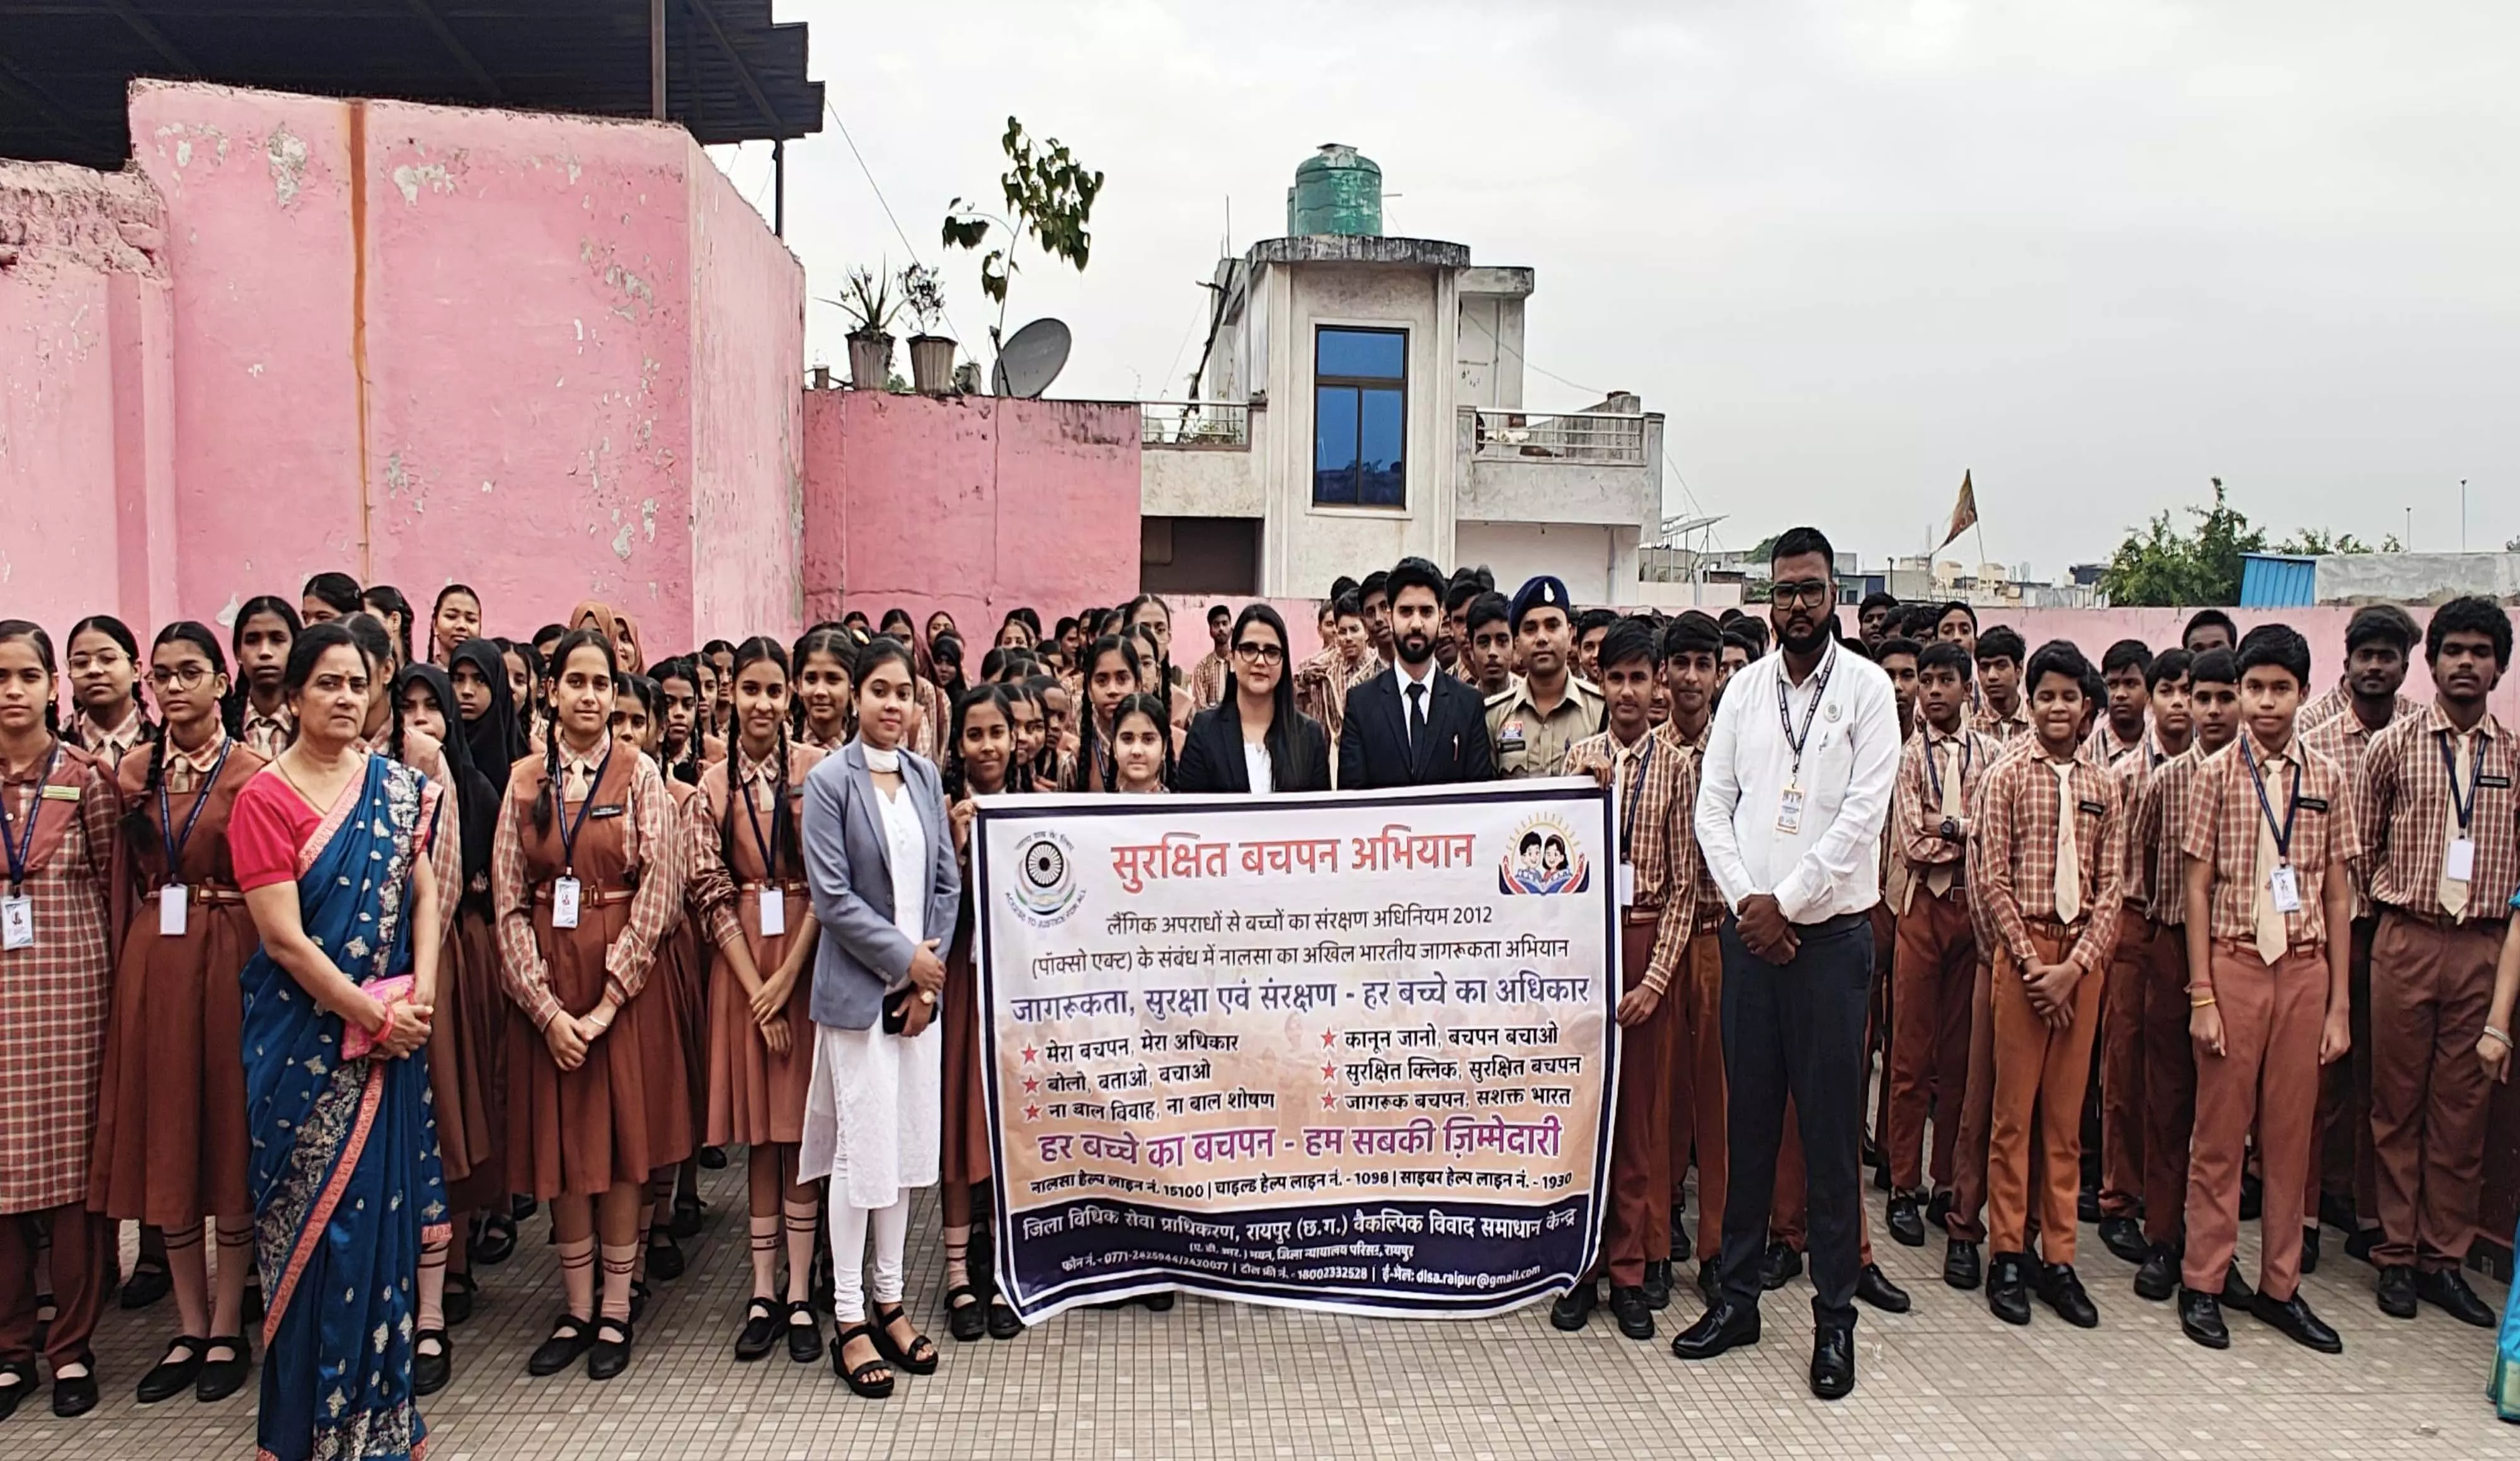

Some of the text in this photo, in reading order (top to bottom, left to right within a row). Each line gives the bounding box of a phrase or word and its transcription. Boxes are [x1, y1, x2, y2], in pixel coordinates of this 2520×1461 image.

[1111, 824, 1476, 893] सुरक्षित बचपन अभियान
[1028, 916, 1036, 926] TO
[1106, 903, 1492, 935] लैंगिक अपराधों से बच्चों का संरक्षण अधिनियम 2012
[1032, 933, 1569, 979] (पॉक्सो एक्ट) के संबंध में नालसा का अखिल भारतीय जागरूकता अभियान
[1011, 990, 1134, 1022] जागरूकता,
[1144, 988, 1208, 1020] सुरक्षा
[1217, 979, 1251, 1015] एवं
[1259, 978, 1337, 1012] संरक्षण
[1363, 982, 1390, 1011] हर
[1397, 971, 1447, 1006] बच्चे
[1455, 980, 1487, 1004] का
[1496, 970, 1589, 1004] अधिकार
[1046, 1029, 1239, 1063] मेरा बचपन, मेरा अधिकार
[1345, 1021, 1558, 1055] कानून जानो, बचपन बचाओ
[1046, 1058, 1211, 1094] बोलो, बताओ, बचाओ
[1346, 1055, 1582, 1086] सुरक्षित क्लिक, सुरक्षित बचपन
[1049, 1087, 1275, 1121] ना बाल विवाह, ना बाल शोषण
[1345, 1087, 1571, 1110] जागरूक बचपन, सशक्त भारत
[1038, 1135, 1073, 1162] हर
[1080, 1132, 1138, 1164] बच्चे
[1146, 1135, 1183, 1167] का
[1193, 1129, 1276, 1162] बचपन
[1304, 1128, 1344, 1156] हम
[1352, 1118, 1436, 1155] सबकी
[1443, 1114, 1562, 1159] ज़िम्मेदारी
[1031, 1174, 1074, 1193] नालसा
[1079, 1169, 1104, 1186] हेल्प
[1108, 1174, 1143, 1192] लाइन
[1164, 1185, 1203, 1198] 15100
[1215, 1178, 1257, 1196] चाइल्ड
[1260, 1173, 1286, 1193] हेल्प
[1290, 1173, 1326, 1191] लाइन
[1400, 1171, 1443, 1186] साइबर
[1446, 1166, 1473, 1186] हेल्प
[1475, 1172, 1512, 1189] लाइन
[1543, 1172, 1572, 1189] 1930
[1023, 1205, 1577, 1244] जिला विधिक सेवा प्राधिकरण, रायपुर (छ.ग.) वैकल्पिक विवाद समाधान केन्द्र
[1062, 1256, 1084, 1271] फोन
